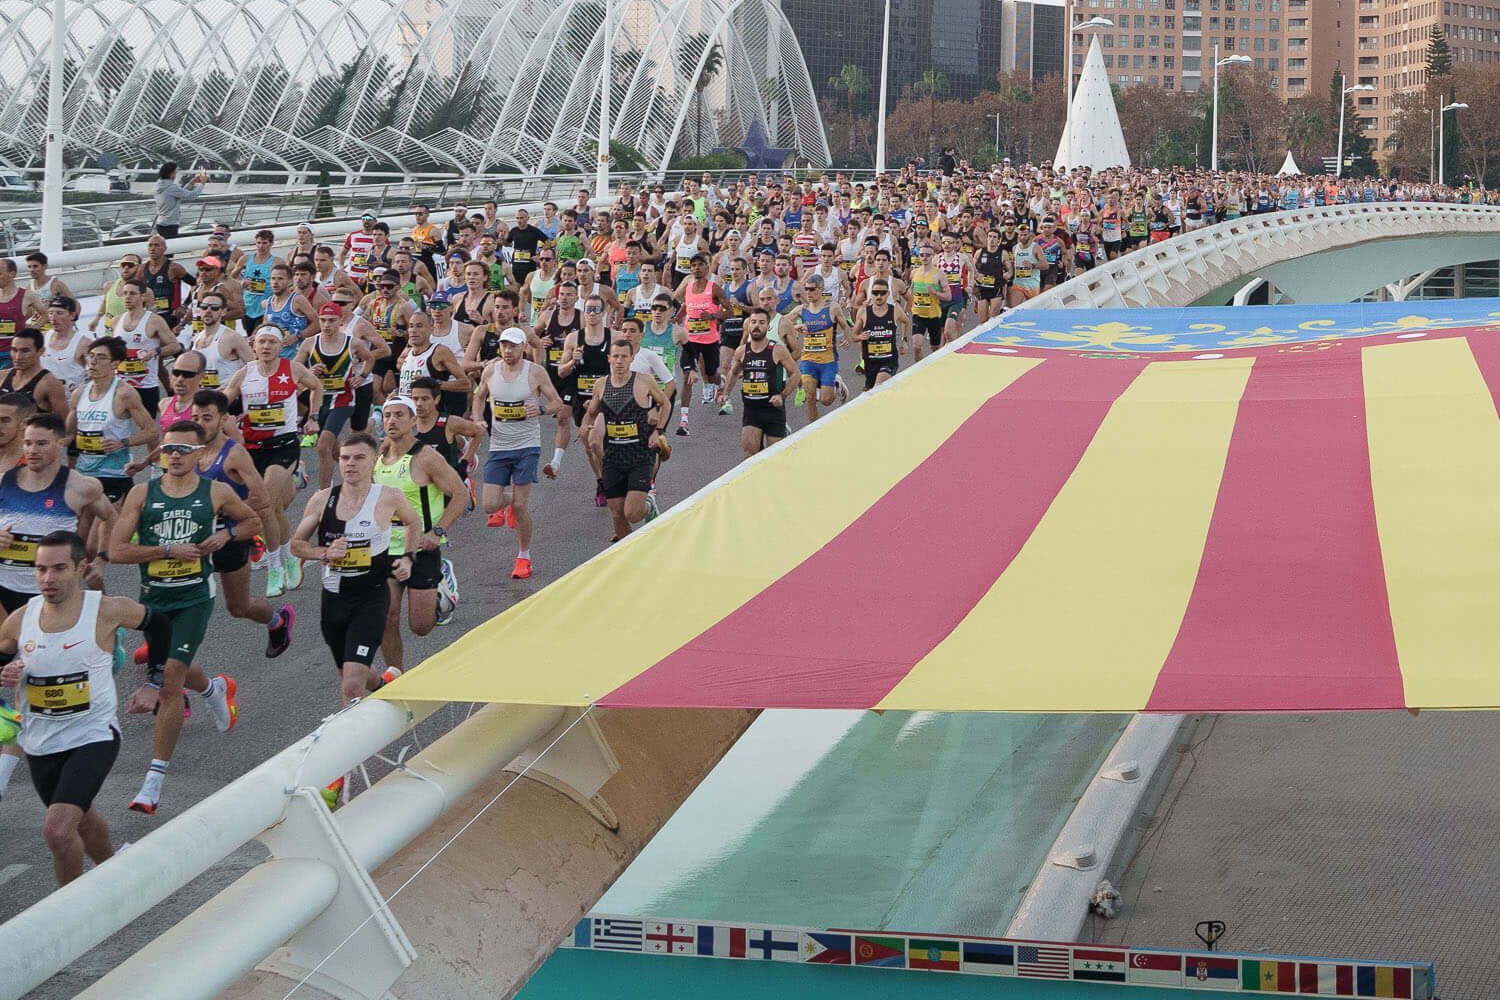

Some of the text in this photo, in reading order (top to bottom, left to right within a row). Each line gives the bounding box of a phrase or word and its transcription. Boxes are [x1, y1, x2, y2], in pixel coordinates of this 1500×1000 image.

[162, 509, 193, 521] EARLS
[153, 518, 199, 539] RUN CLUB
